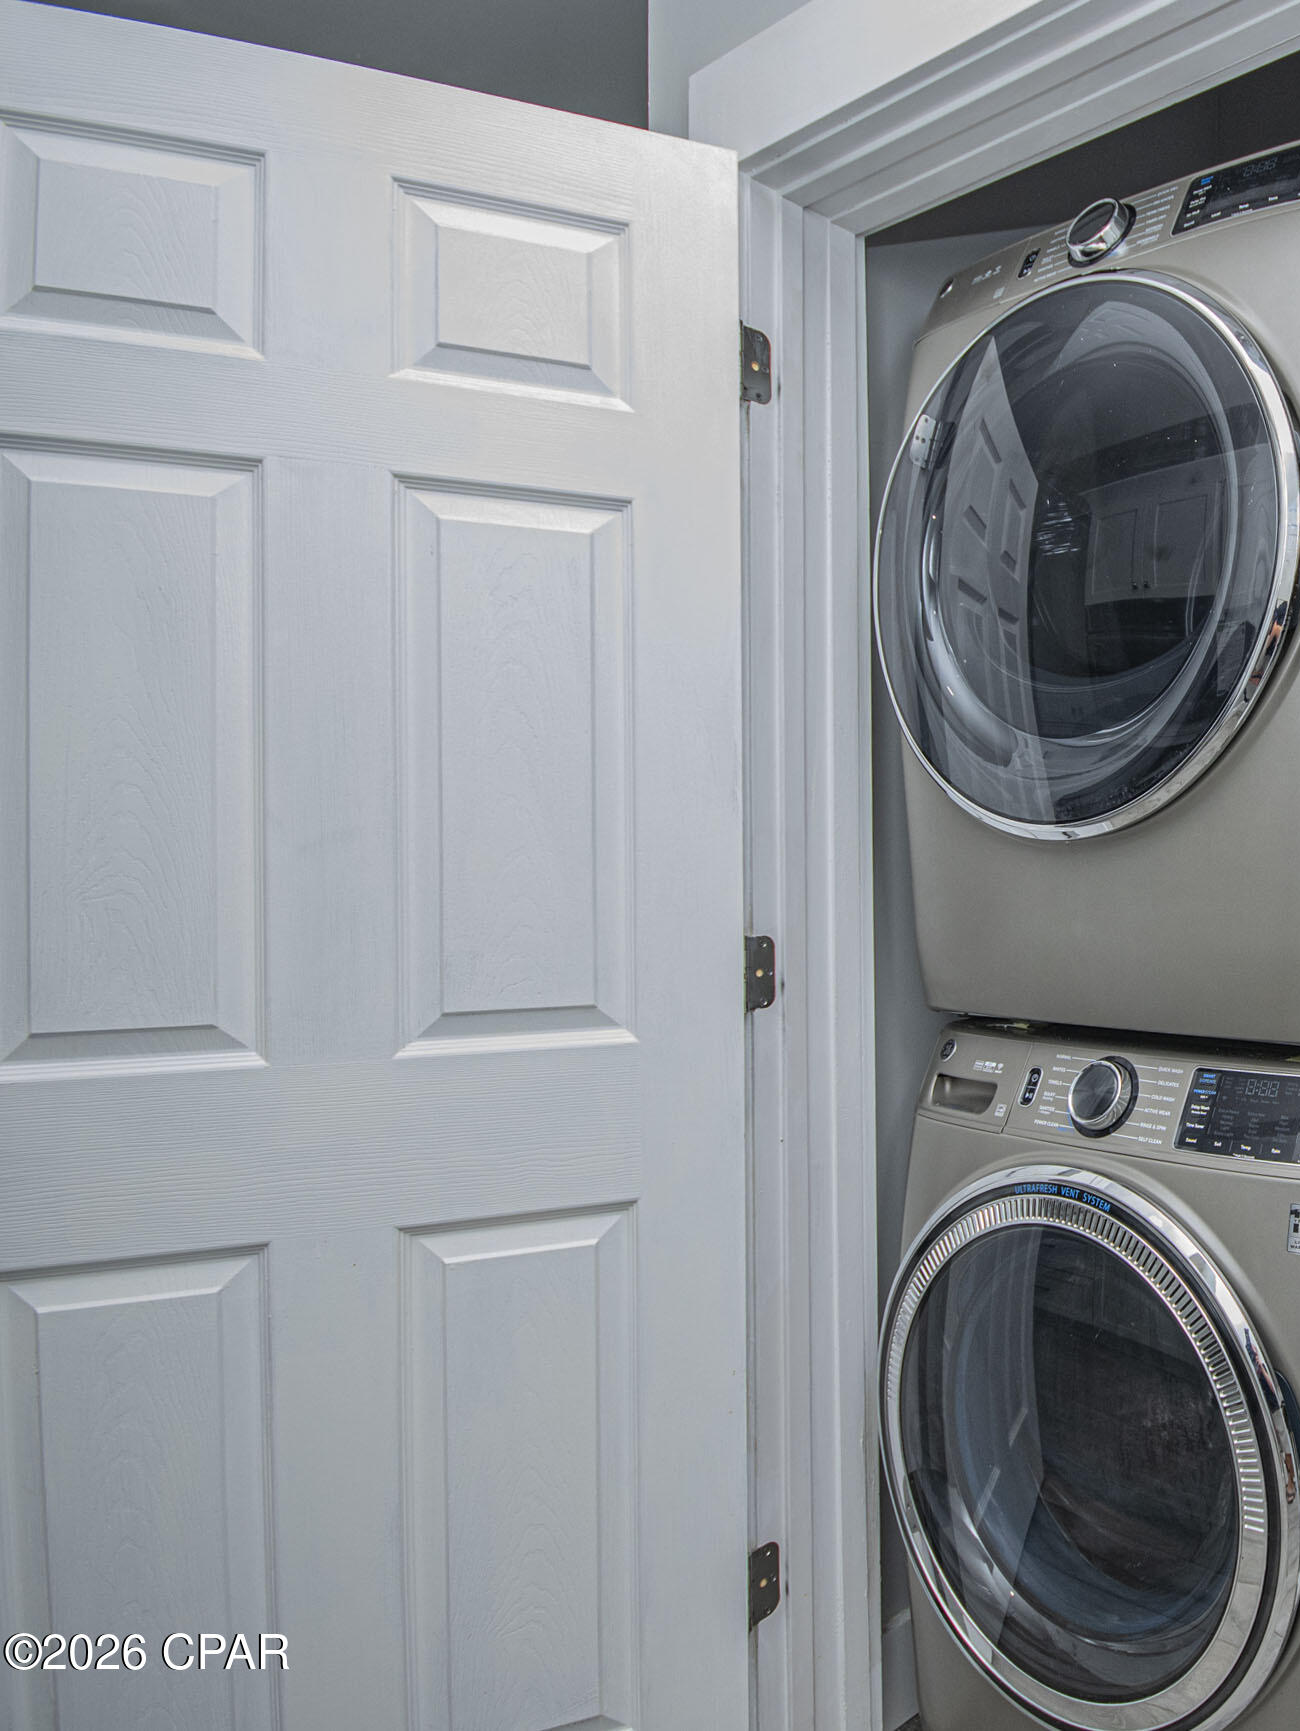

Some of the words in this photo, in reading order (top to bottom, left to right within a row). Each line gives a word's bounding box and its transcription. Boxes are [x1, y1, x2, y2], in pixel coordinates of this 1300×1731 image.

[1014, 1183, 1058, 1194] ULTRAFRESH
[1061, 1186, 1080, 1199] VENT
[1082, 1192, 1111, 1212] SYSTEM
